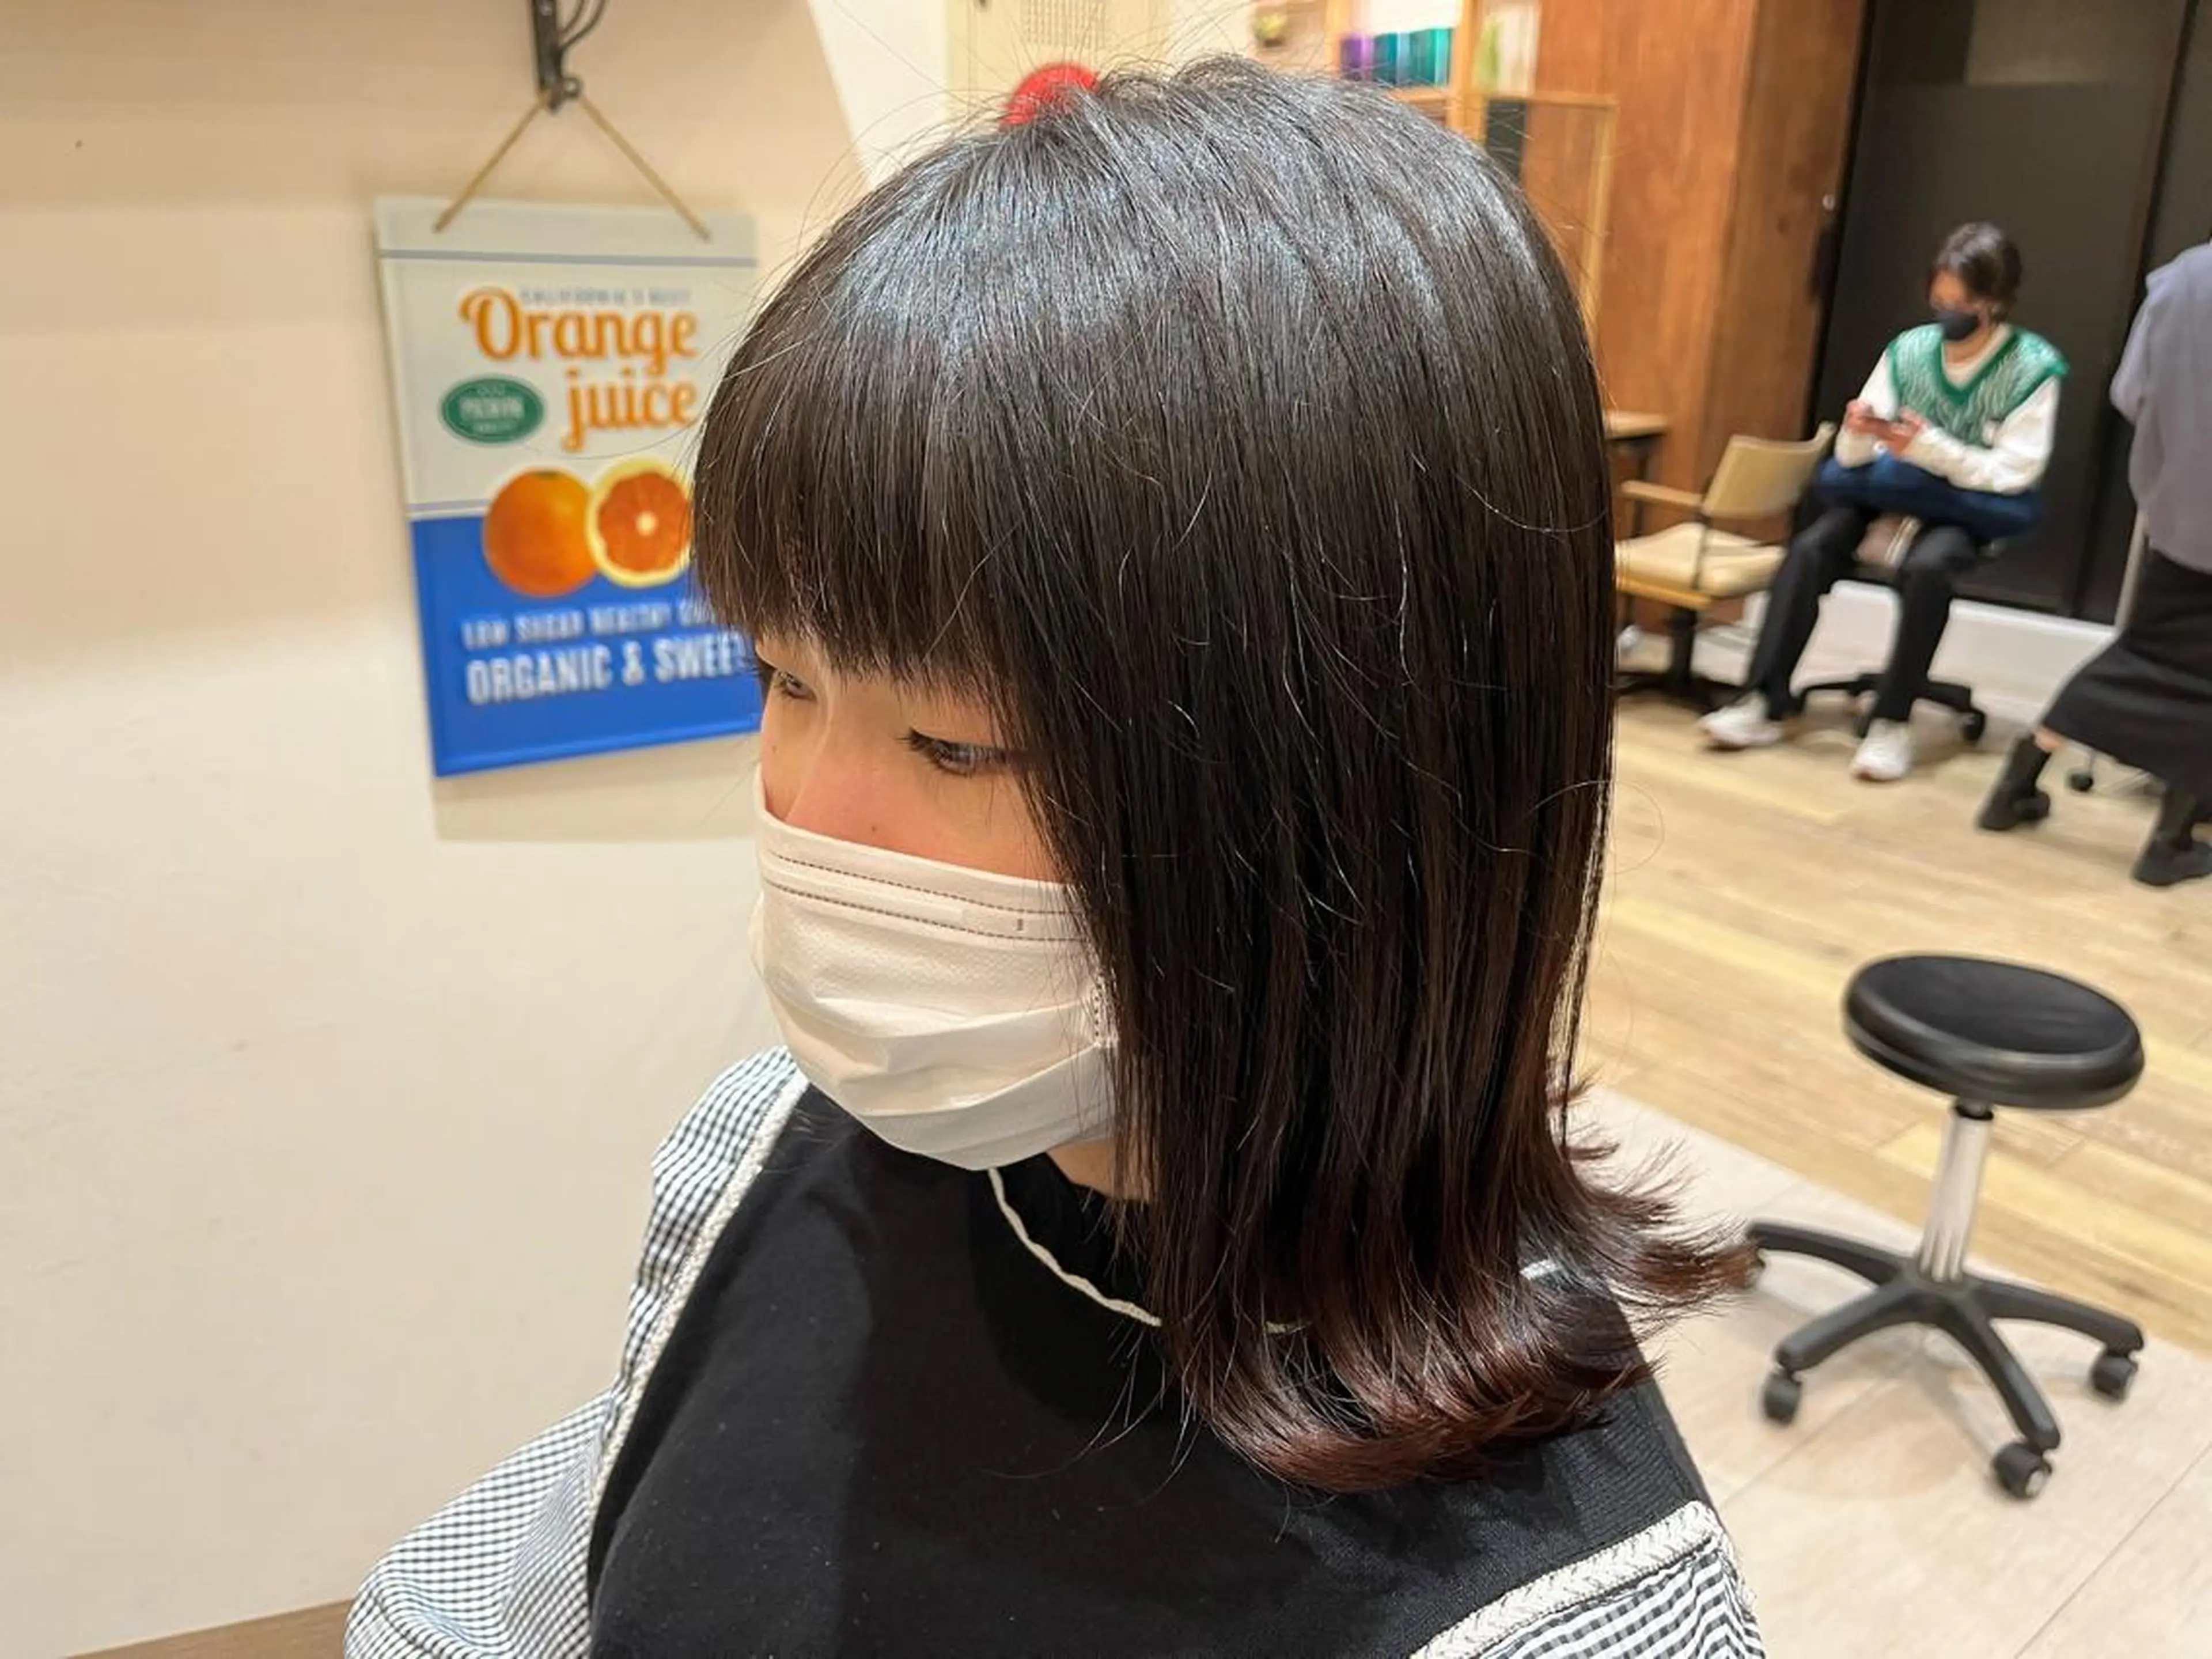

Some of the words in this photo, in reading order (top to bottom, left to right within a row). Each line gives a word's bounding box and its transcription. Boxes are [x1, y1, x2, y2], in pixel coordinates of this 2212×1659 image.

[459, 287, 698, 375] Orange
[563, 368, 698, 453] juice
[466, 645, 612, 704] ORGANIC
[623, 641, 645, 685] &
